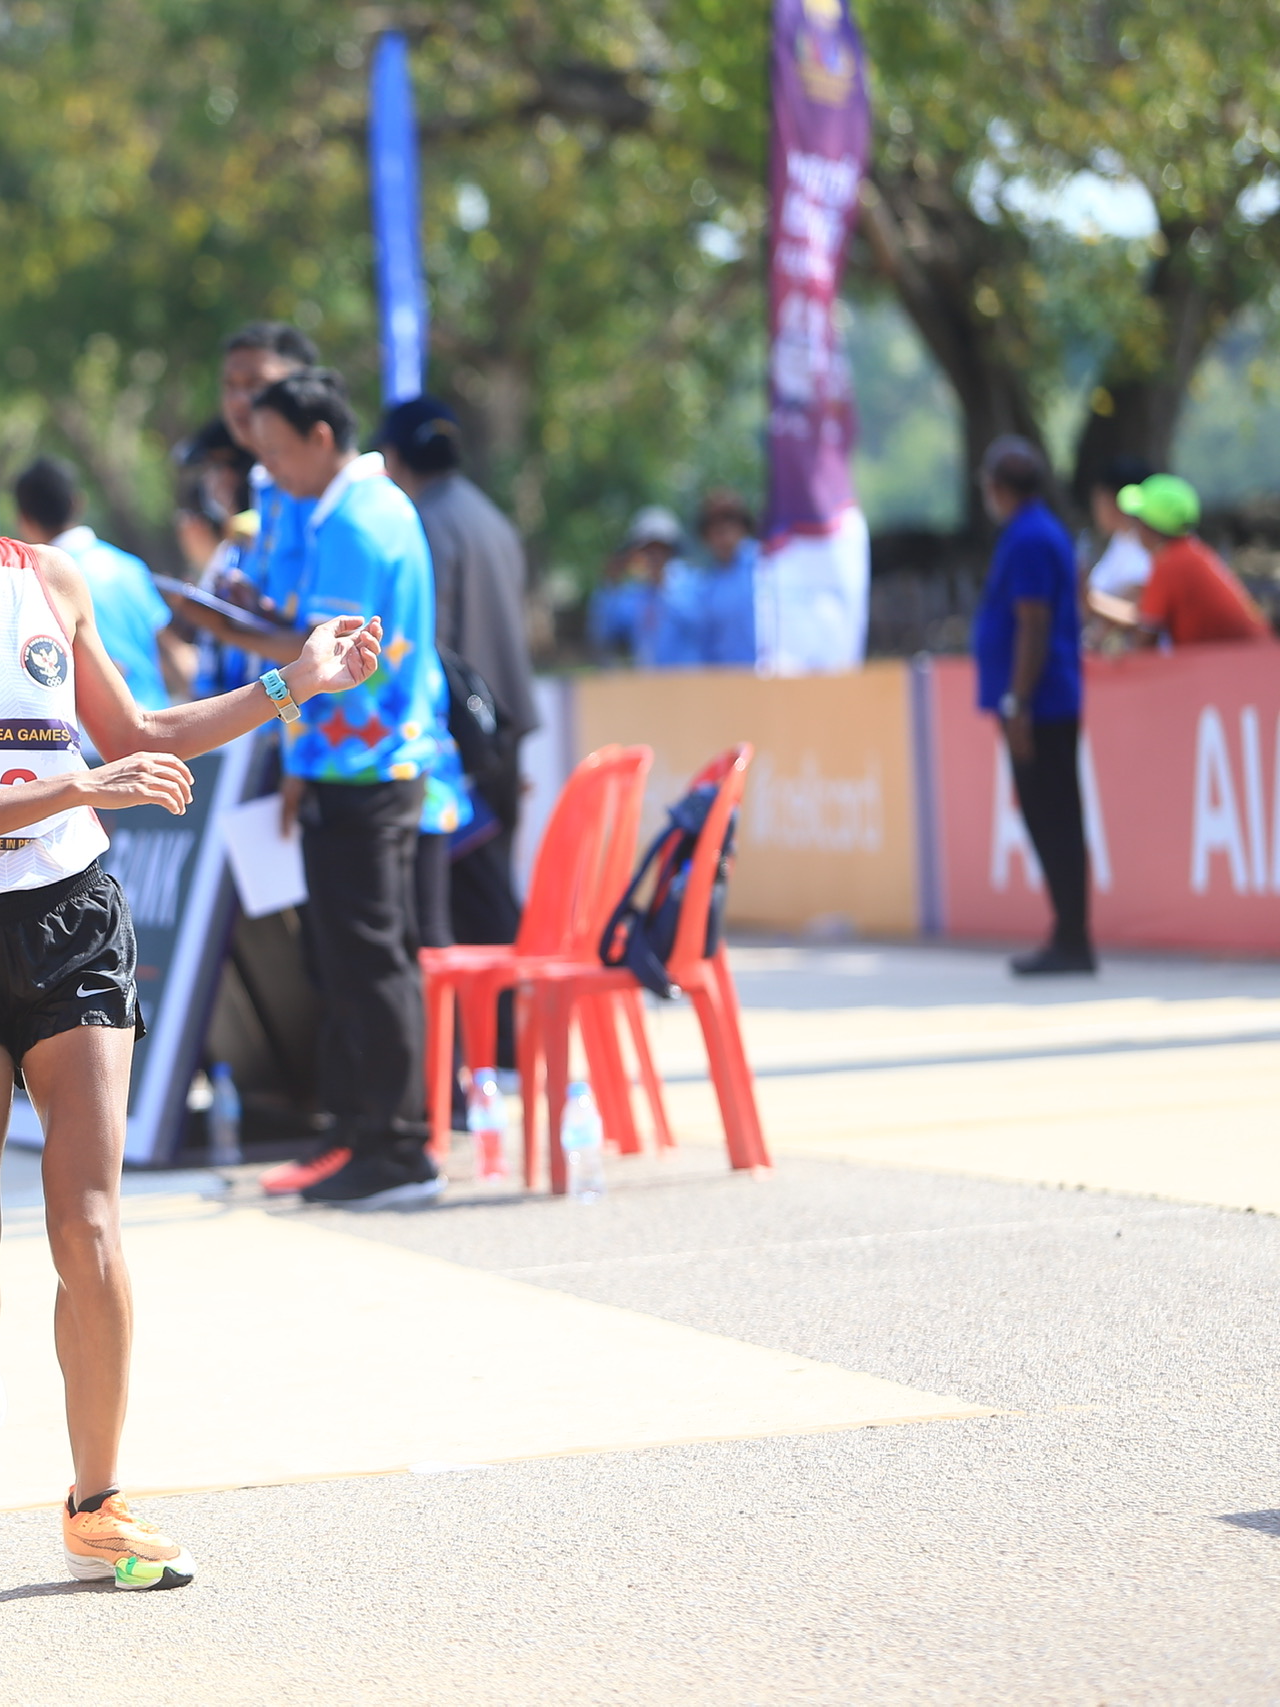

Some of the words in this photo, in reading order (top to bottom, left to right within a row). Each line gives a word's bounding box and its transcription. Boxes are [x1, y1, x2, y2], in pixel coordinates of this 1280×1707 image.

[17, 729, 71, 741] GAMES
[1190, 703, 1280, 895] AI
[6, 839, 16, 849] IN
